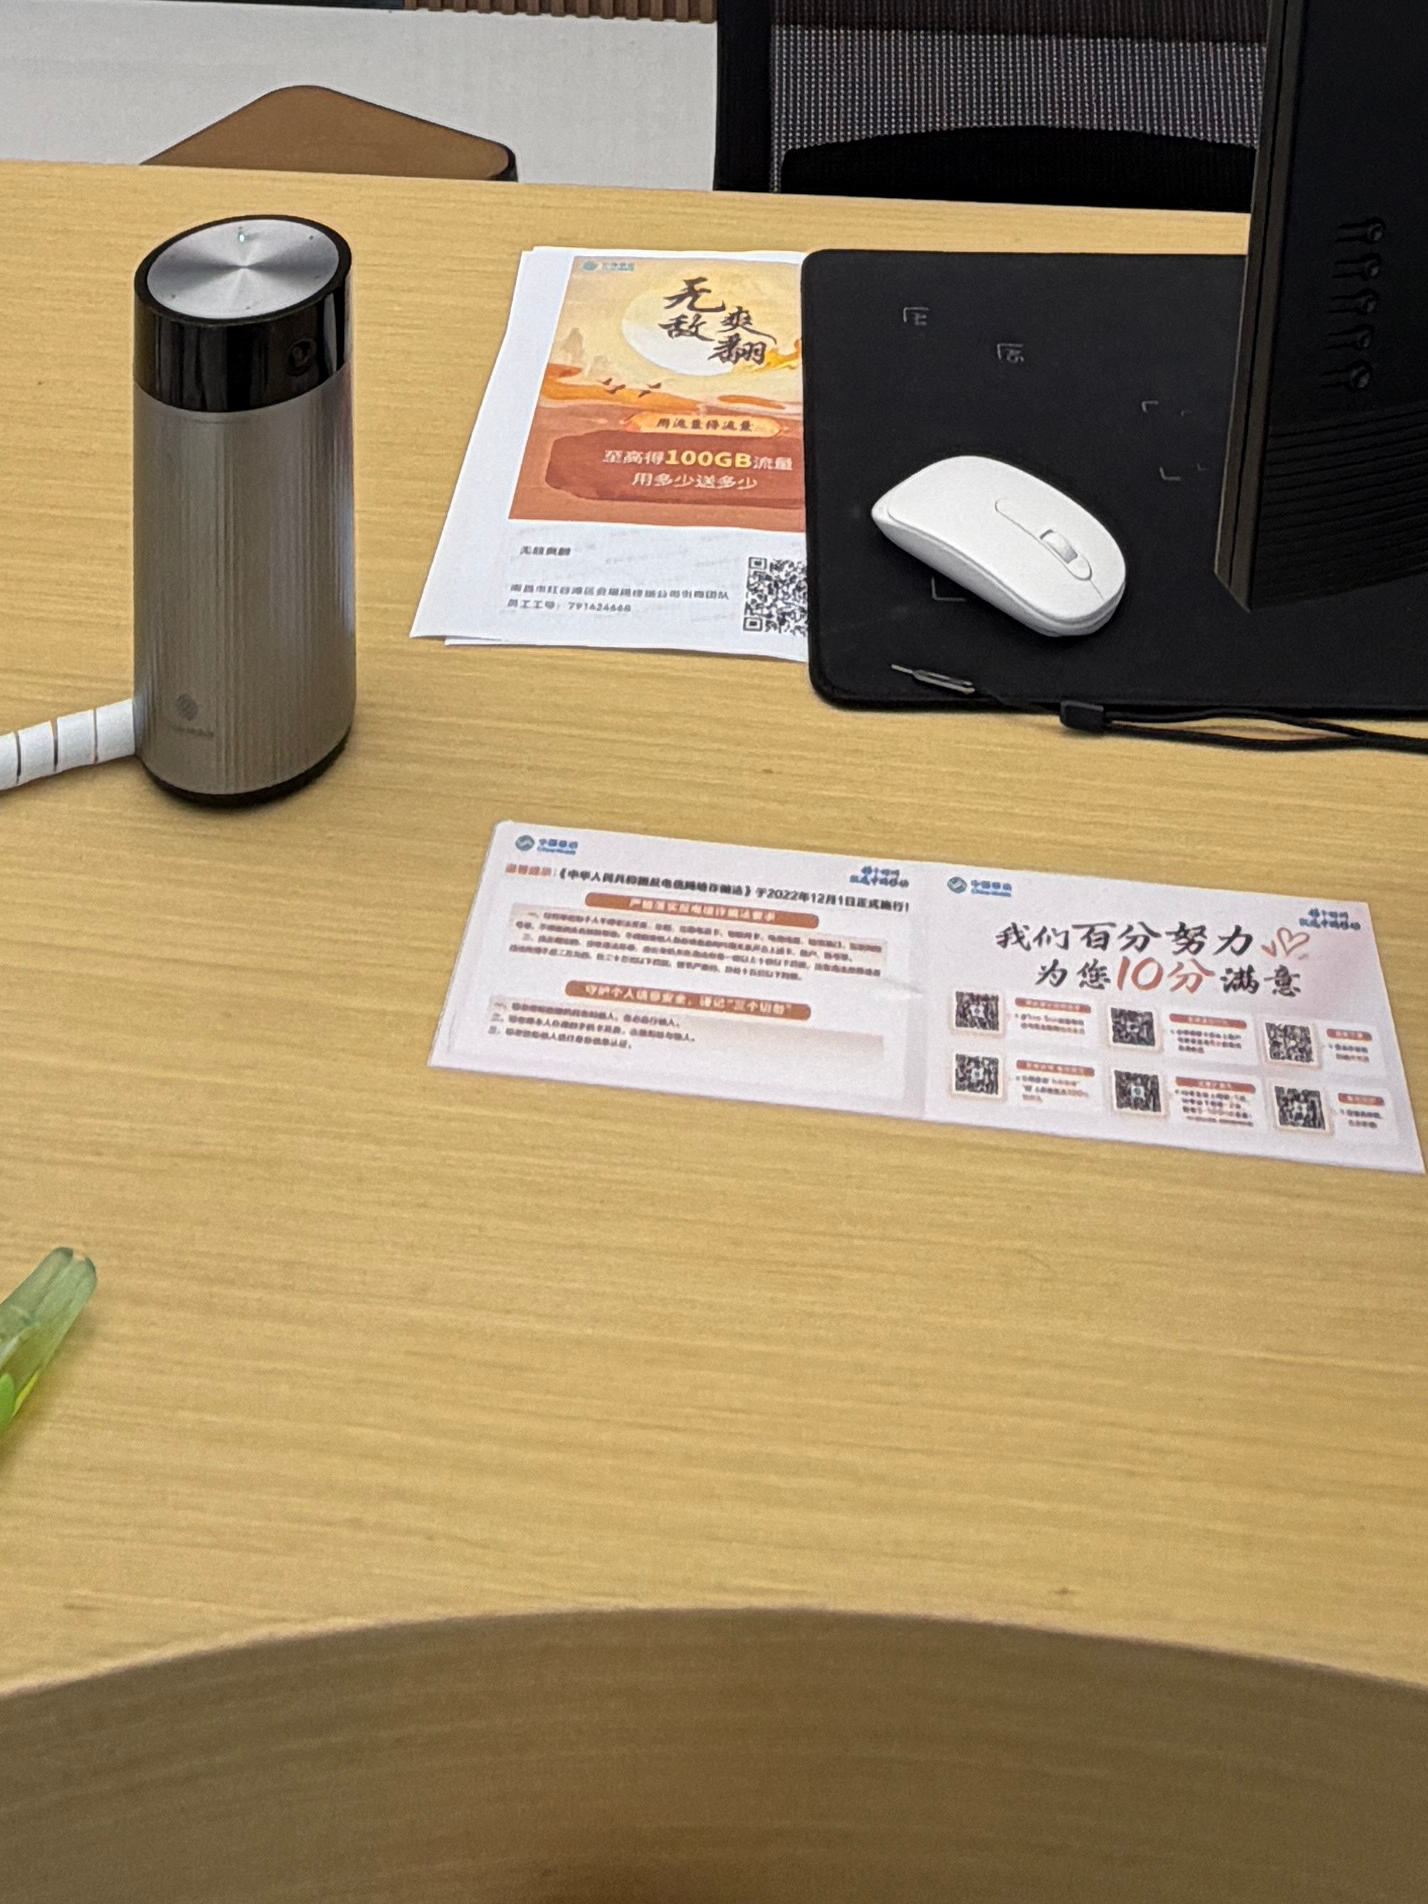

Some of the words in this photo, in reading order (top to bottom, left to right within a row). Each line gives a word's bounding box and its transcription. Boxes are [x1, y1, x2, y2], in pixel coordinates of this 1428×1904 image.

[602, 449, 793, 472] 至高得100GB流量
[632, 472, 758, 490] 用多少送多少
[995, 921, 1254, 958] 我们百分努力
[1035, 956, 1302, 998] 为您10分满意
